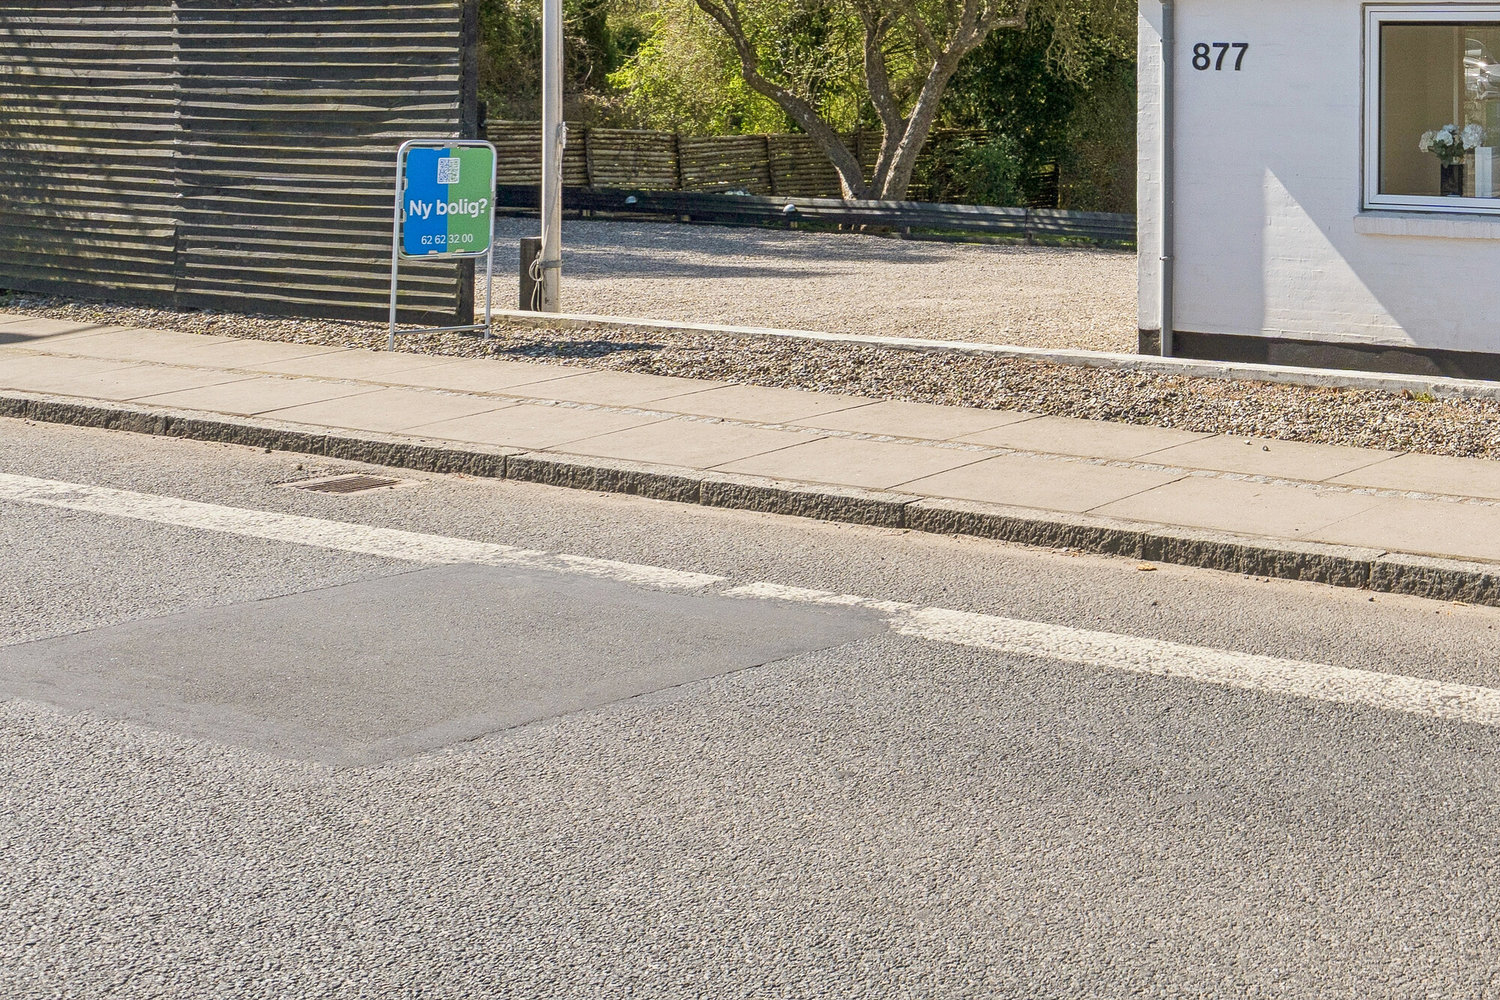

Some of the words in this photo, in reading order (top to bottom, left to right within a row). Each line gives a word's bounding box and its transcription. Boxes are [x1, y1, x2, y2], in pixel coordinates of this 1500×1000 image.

[1192, 42, 1249, 71] 877
[409, 200, 433, 220] Ny
[436, 198, 488, 219] bolig?
[421, 234, 433, 245] 62
[434, 234, 446, 245] 62
[448, 233, 460, 244] 32
[461, 233, 473, 243] 00
